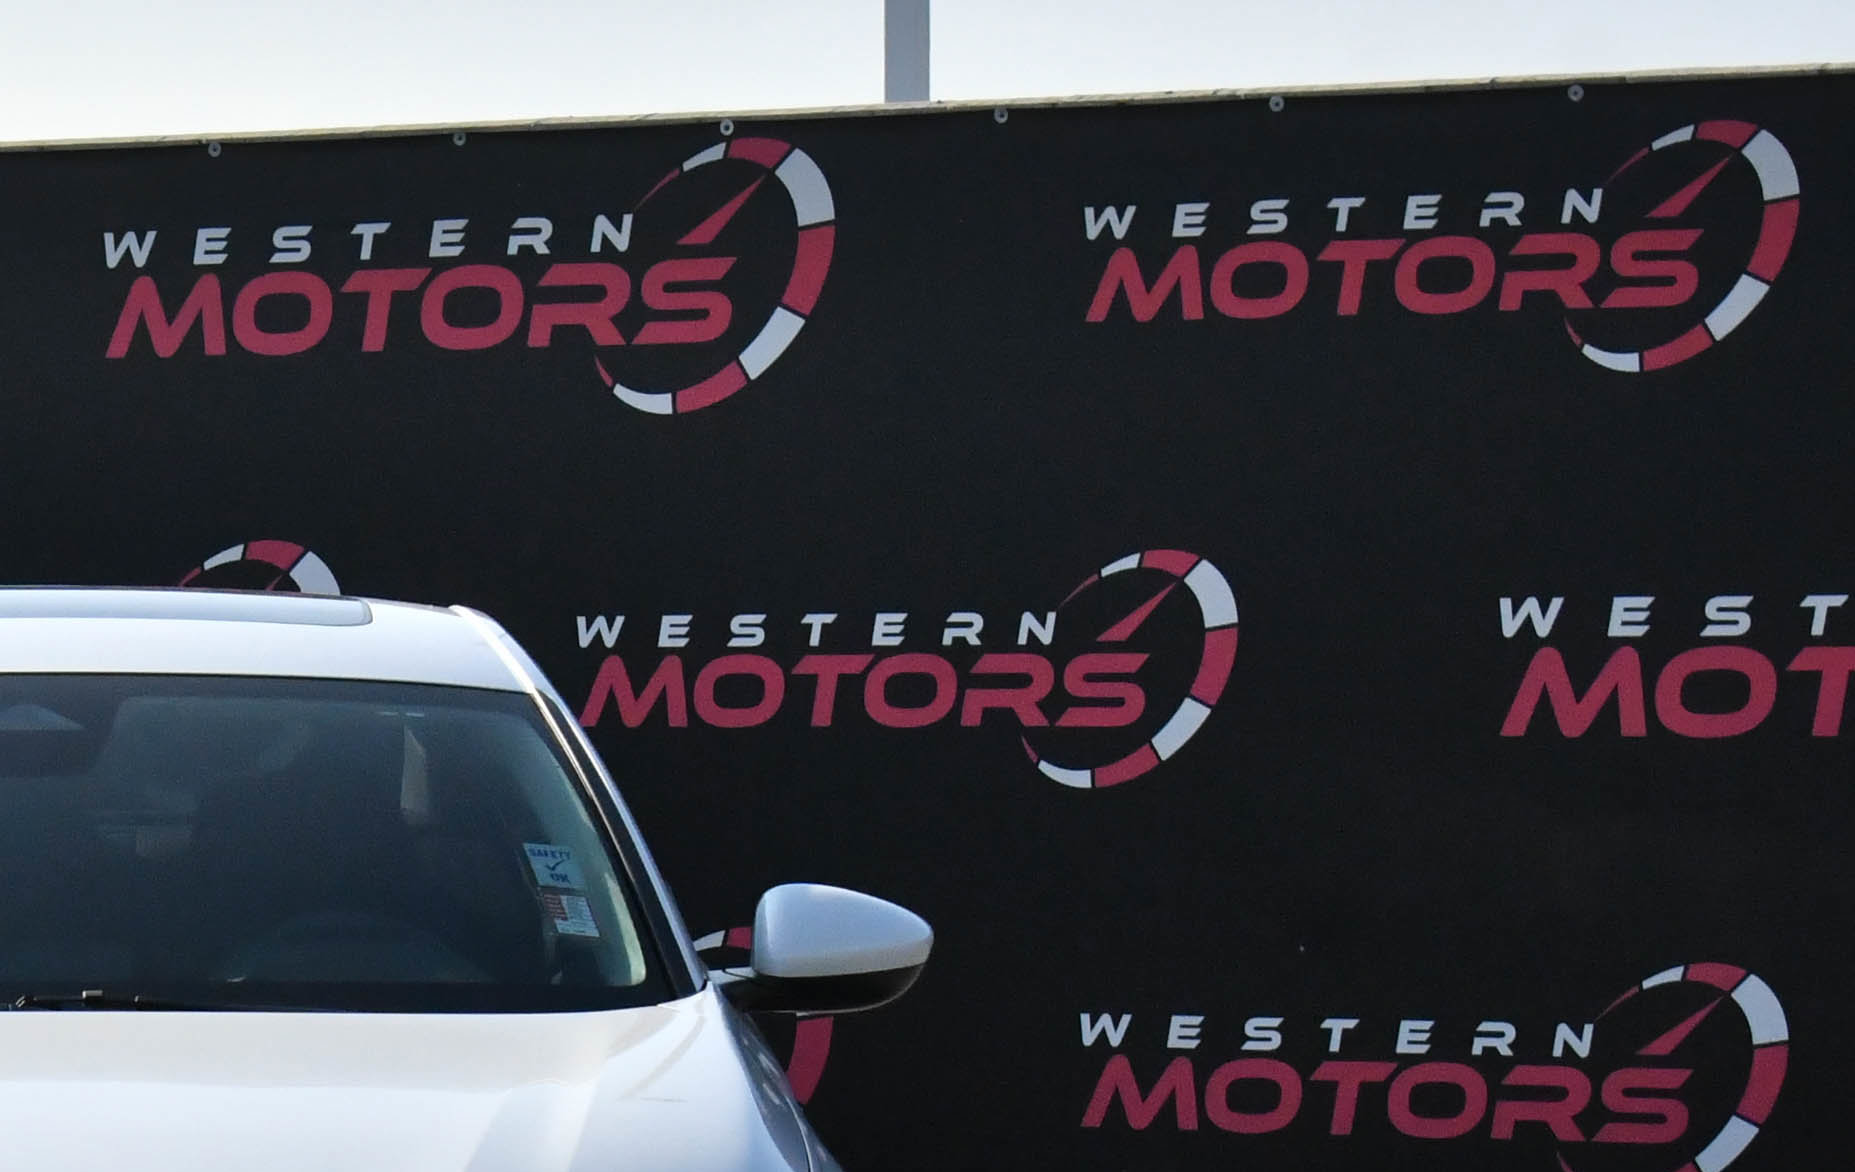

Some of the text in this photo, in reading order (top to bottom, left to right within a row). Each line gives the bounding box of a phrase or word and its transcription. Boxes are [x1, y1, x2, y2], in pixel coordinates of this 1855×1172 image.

[104, 214, 633, 268] WESTERN
[1085, 188, 1603, 240] WESTERN
[1088, 229, 1704, 322] MOTORS
[107, 256, 736, 358] MOTORS
[577, 613, 1055, 648] WESTERN
[1499, 595, 1849, 638] WEST
[578, 652, 1148, 728] MOTORS
[1080, 1013, 1593, 1058] WESTERN
[1082, 1054, 1692, 1144] MOTORS
